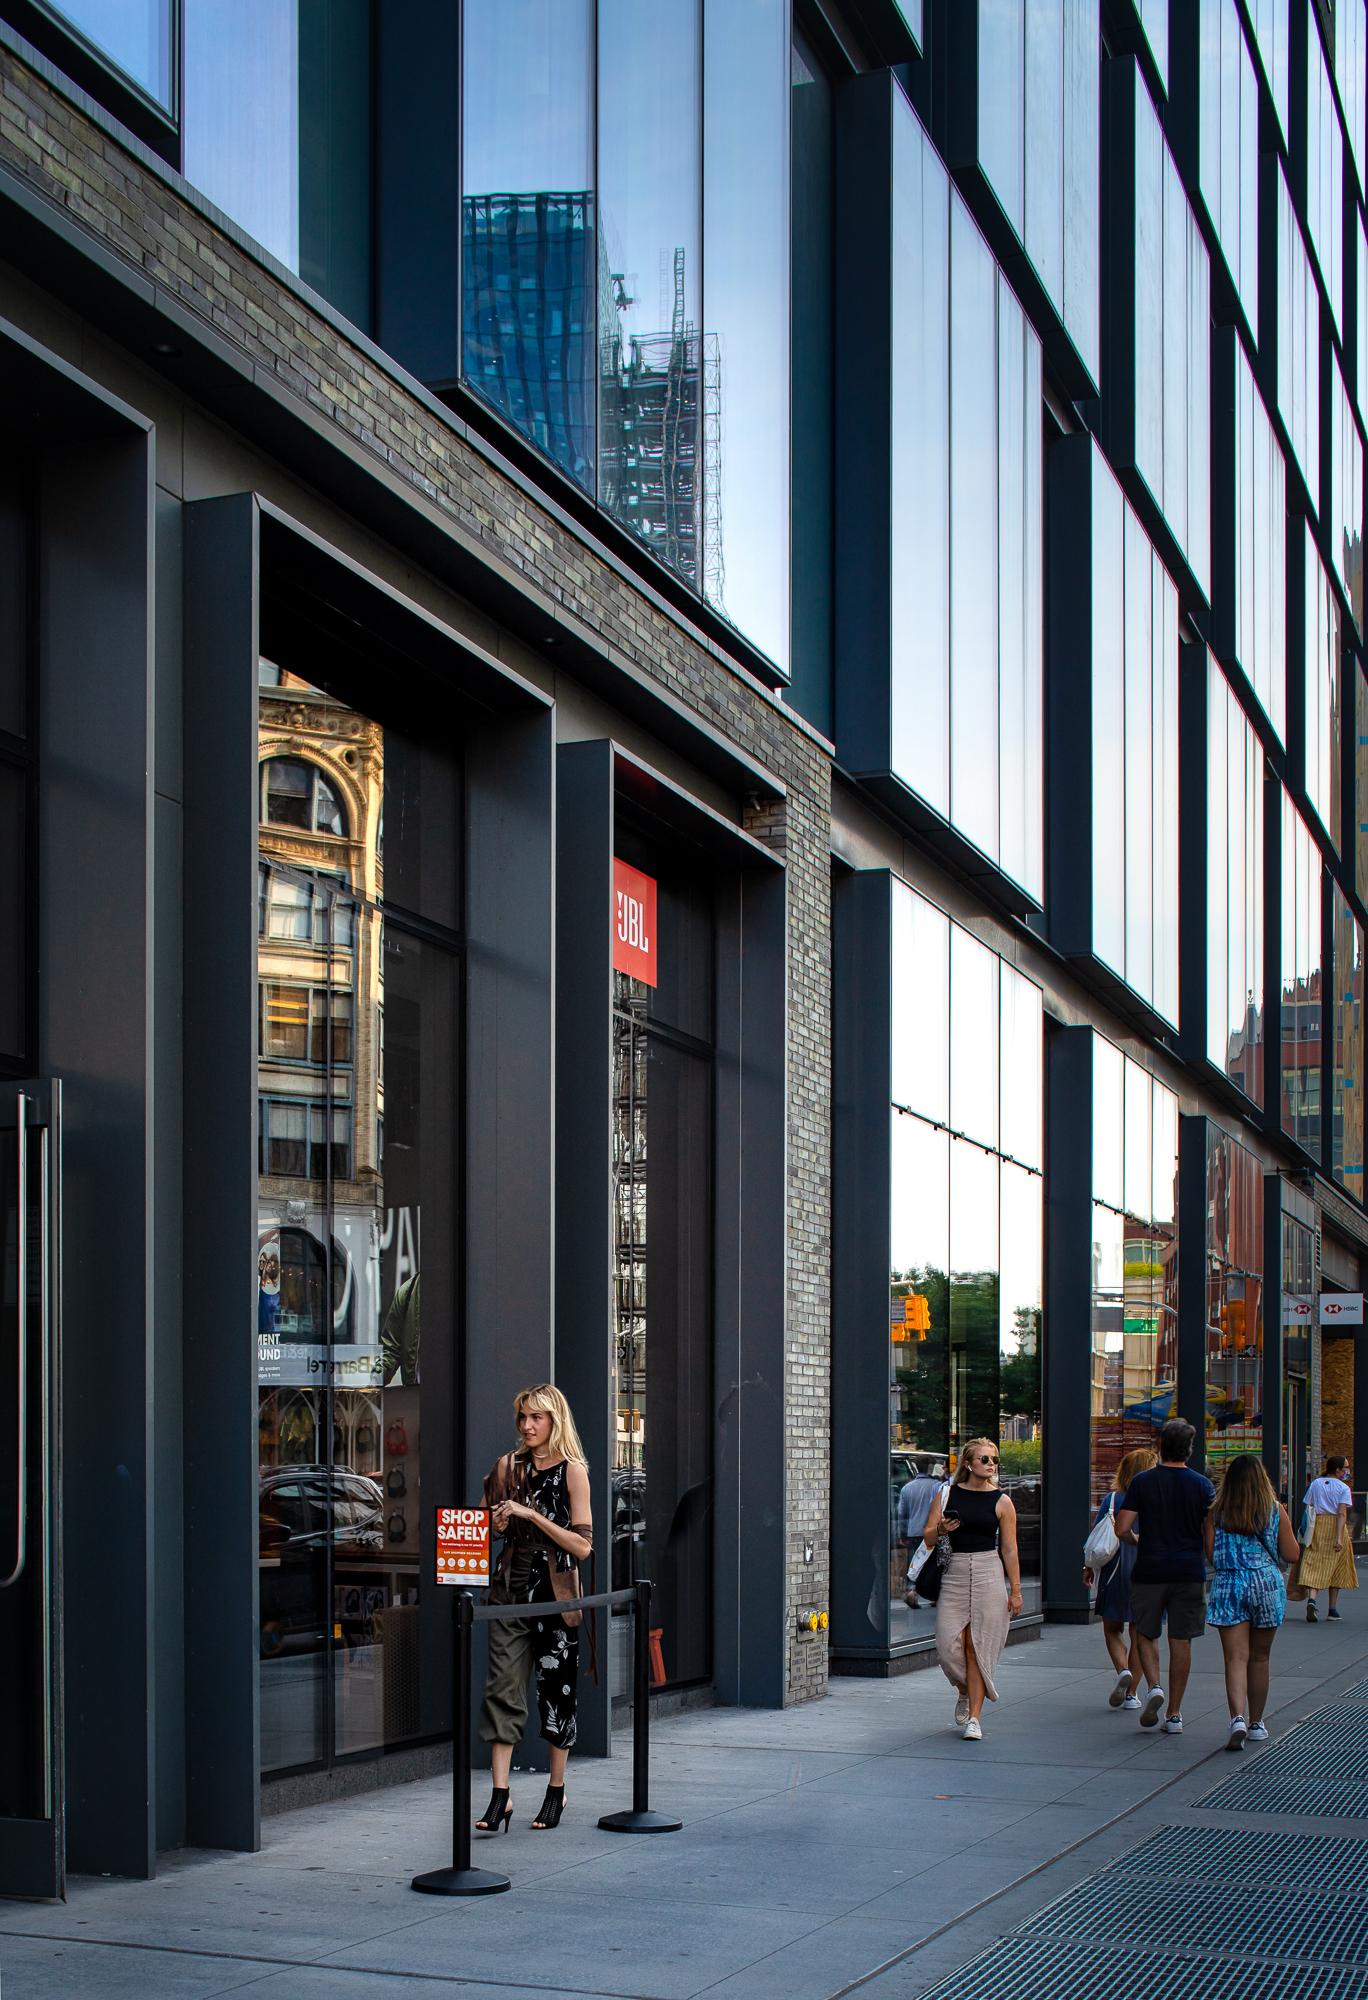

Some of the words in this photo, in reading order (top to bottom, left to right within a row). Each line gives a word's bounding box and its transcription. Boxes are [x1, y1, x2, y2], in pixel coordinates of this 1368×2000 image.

[617, 890, 648, 953] JBL
[442, 1509, 484, 1524] SHOP
[437, 1525, 488, 1541] SAFELY
